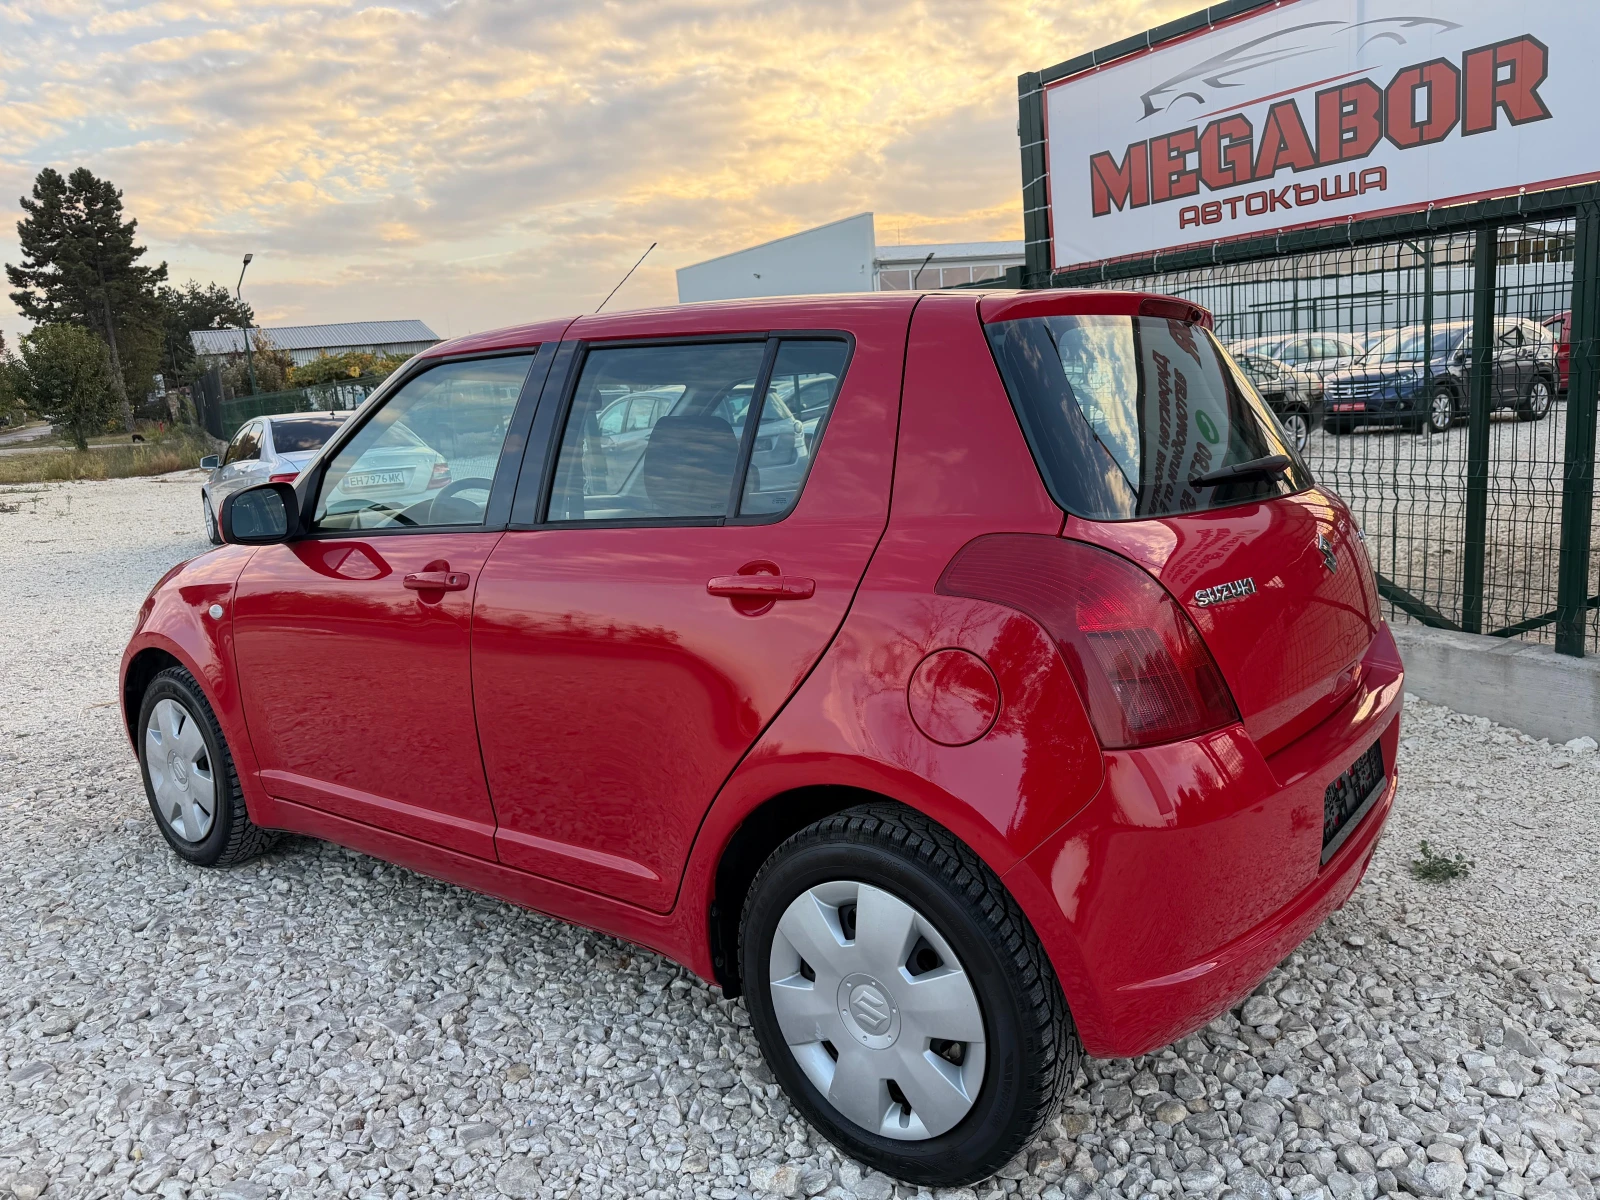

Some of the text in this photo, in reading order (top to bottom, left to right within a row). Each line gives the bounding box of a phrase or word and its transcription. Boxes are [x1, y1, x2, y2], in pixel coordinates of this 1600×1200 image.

[1089, 33, 1553, 218] MEGABOR
[1179, 166, 1388, 230] АВТОКЪЩА
[1194, 577, 1257, 608] SUZUKI
